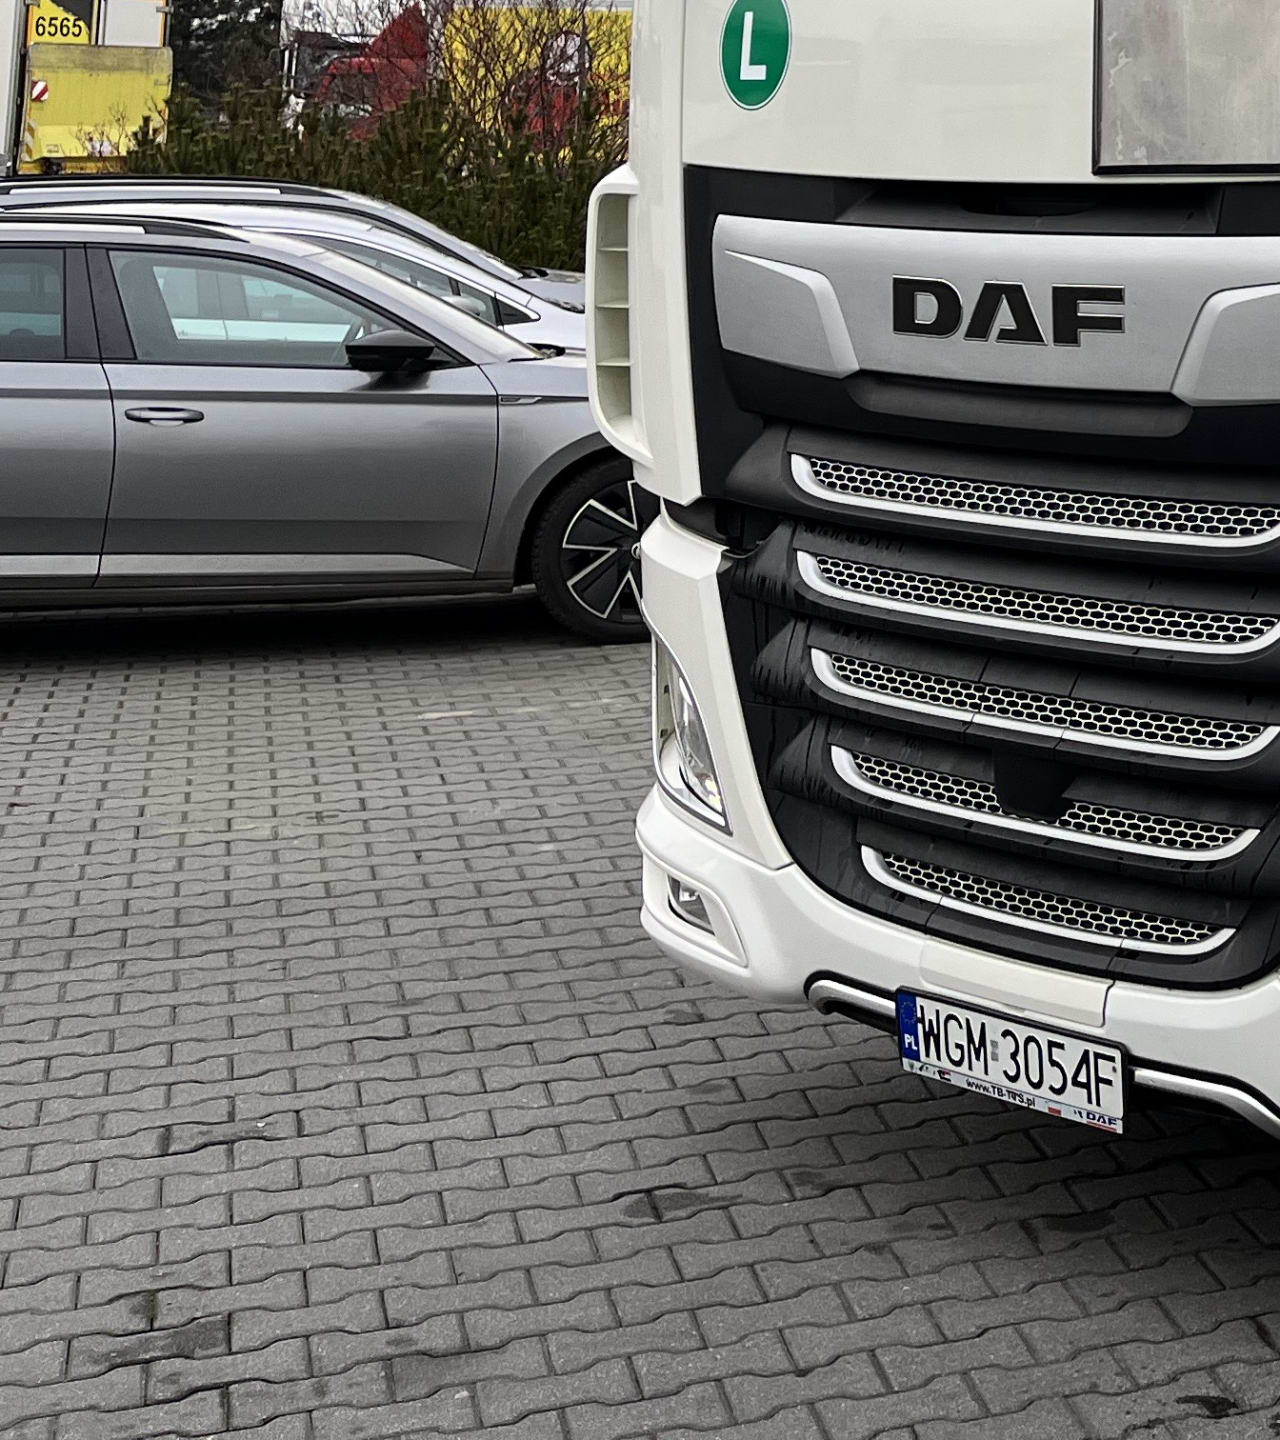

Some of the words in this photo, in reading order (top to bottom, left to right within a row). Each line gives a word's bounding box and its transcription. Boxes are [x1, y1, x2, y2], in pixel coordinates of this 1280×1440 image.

[35, 15, 83, 38] 6565
[740, 11, 767, 81] L
[892, 274, 1126, 347] DAF
[904, 1033, 918, 1051] PL
